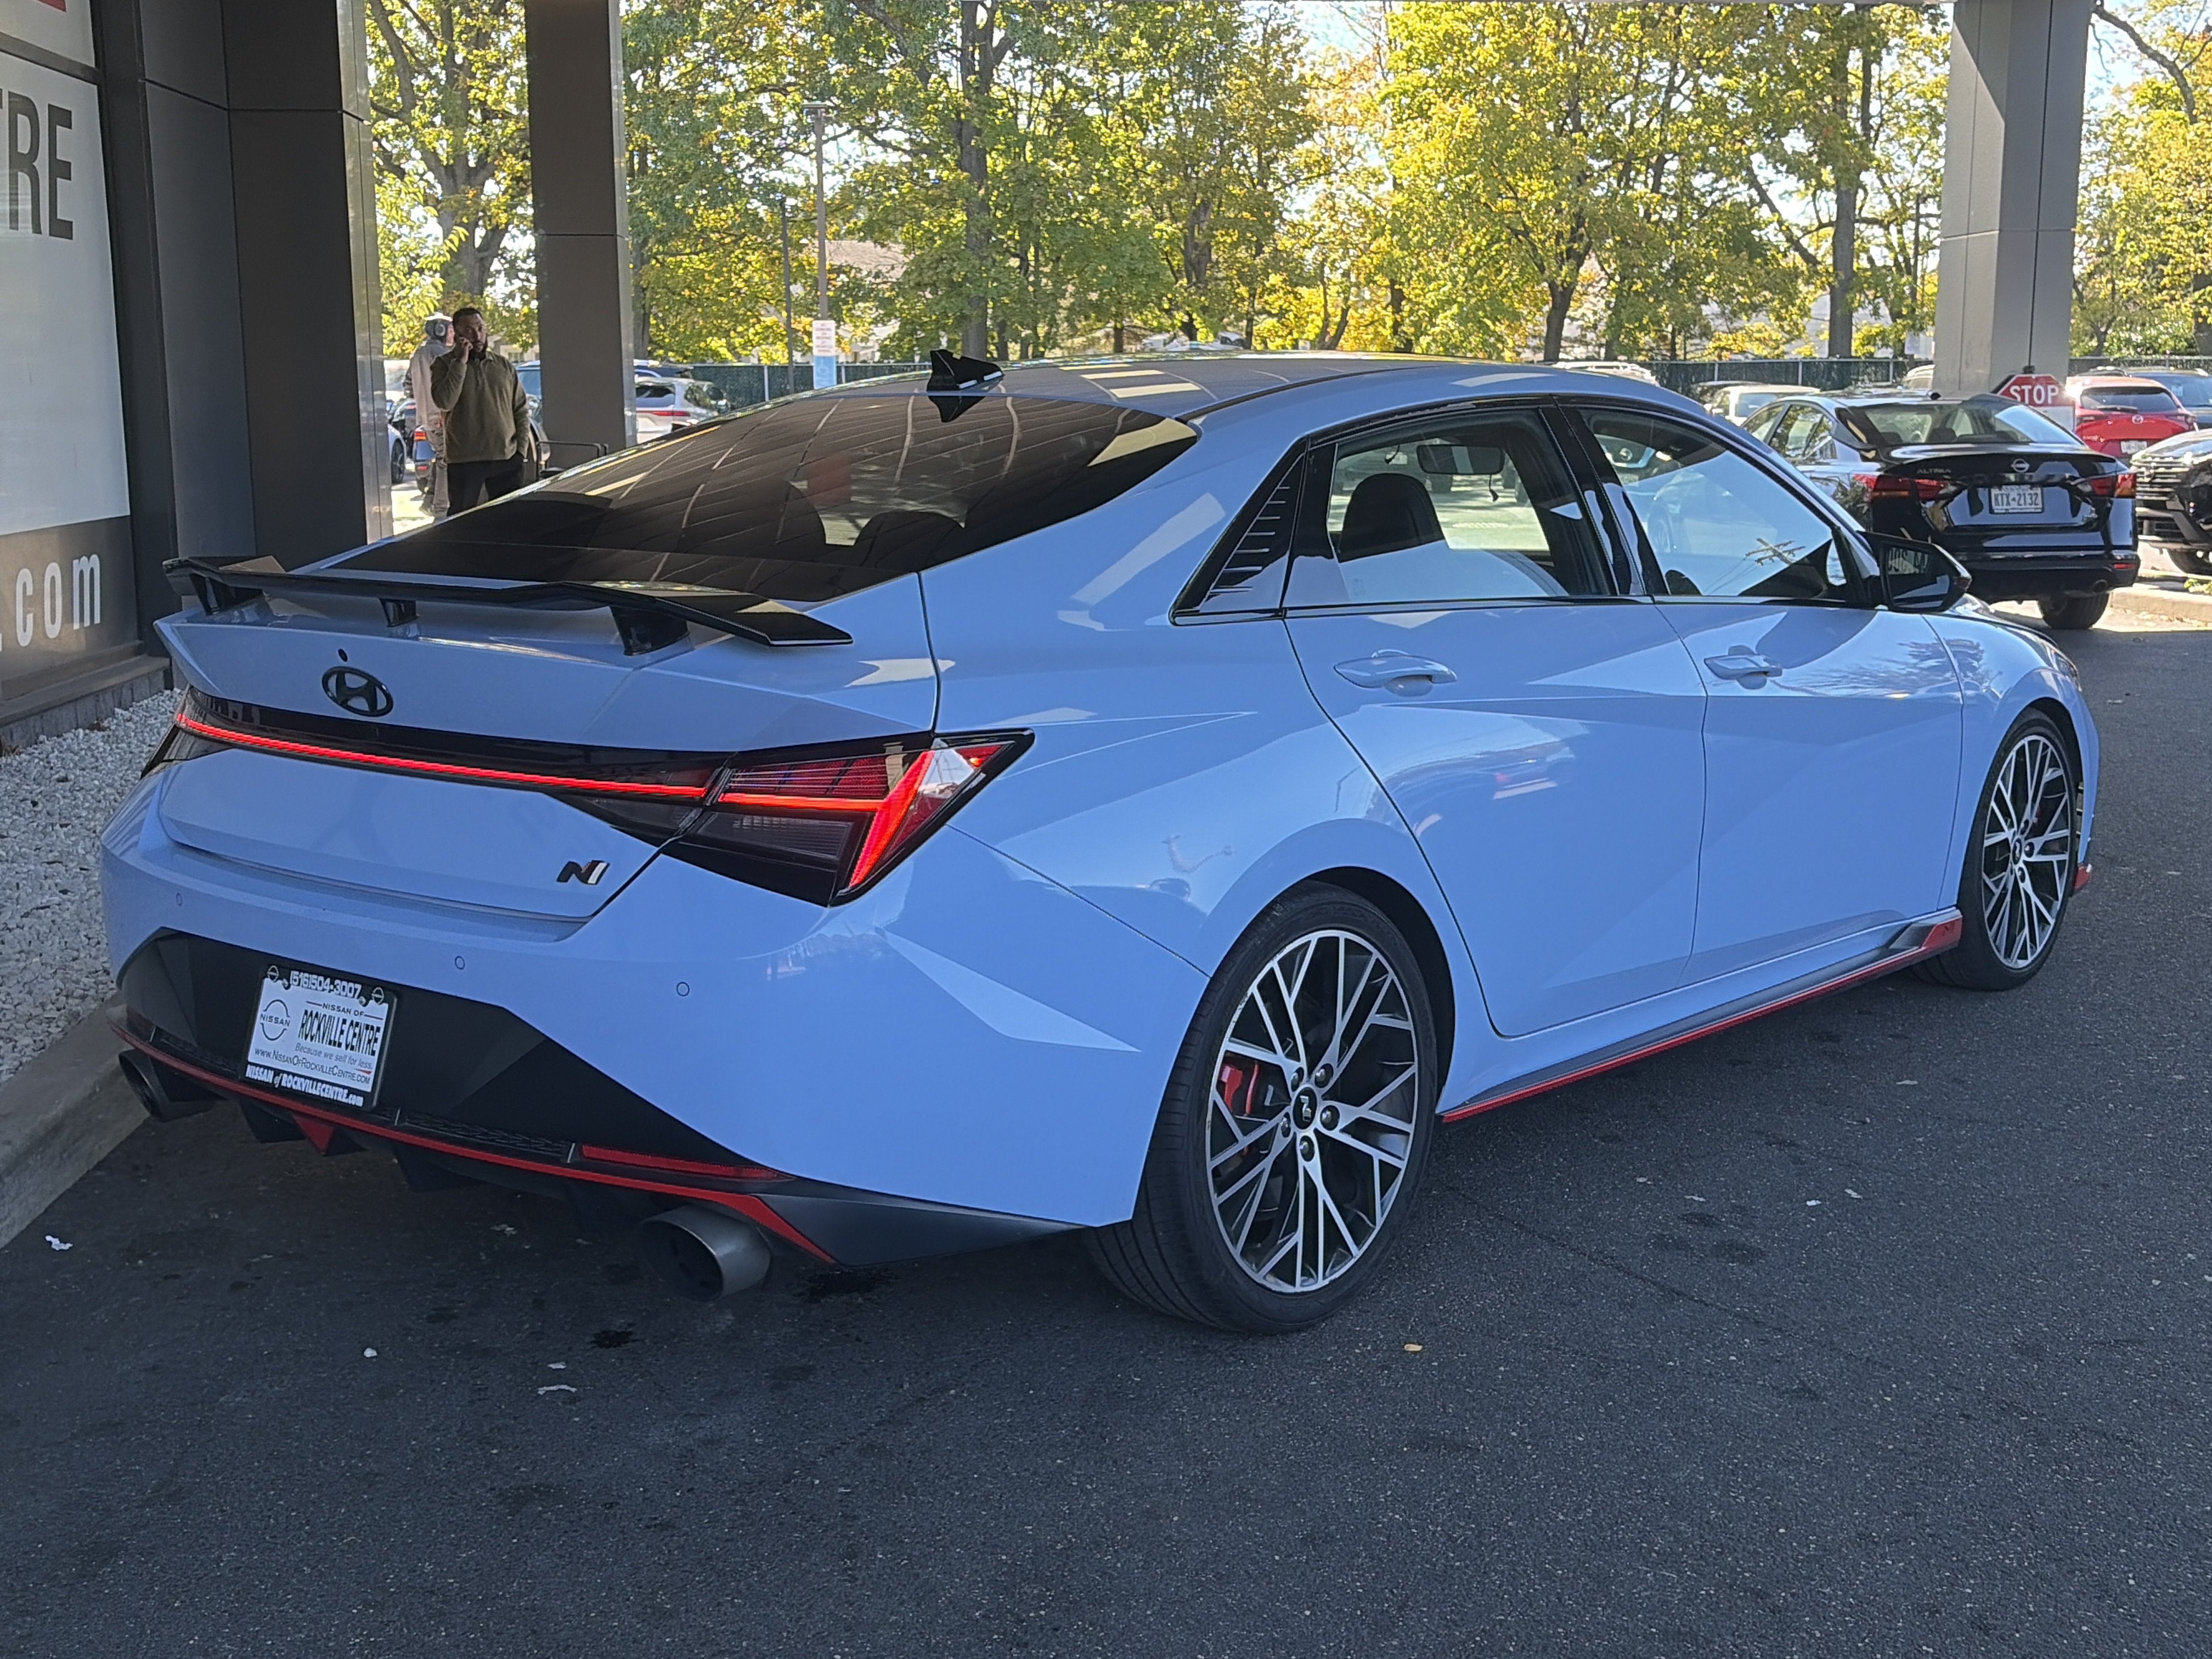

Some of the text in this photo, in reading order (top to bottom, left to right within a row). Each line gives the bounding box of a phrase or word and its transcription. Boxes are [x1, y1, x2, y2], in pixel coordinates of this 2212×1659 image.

[0, 88, 73, 240] RE
[2010, 385, 2059, 405] STOP
[260, 1013, 290, 1026] NISSAN
[322, 1002, 365, 1018] NISSAN OF
[298, 1009, 381, 1057] ROCKVILLE CENTRE
[295, 1042, 322, 1057] Because
[324, 1051, 332, 1059] we
[335, 1053, 347, 1063] sell
[347, 1056, 357, 1065] for
[245, 1064, 274, 1083] NISSAN
[274, 1073, 283, 1088] of
